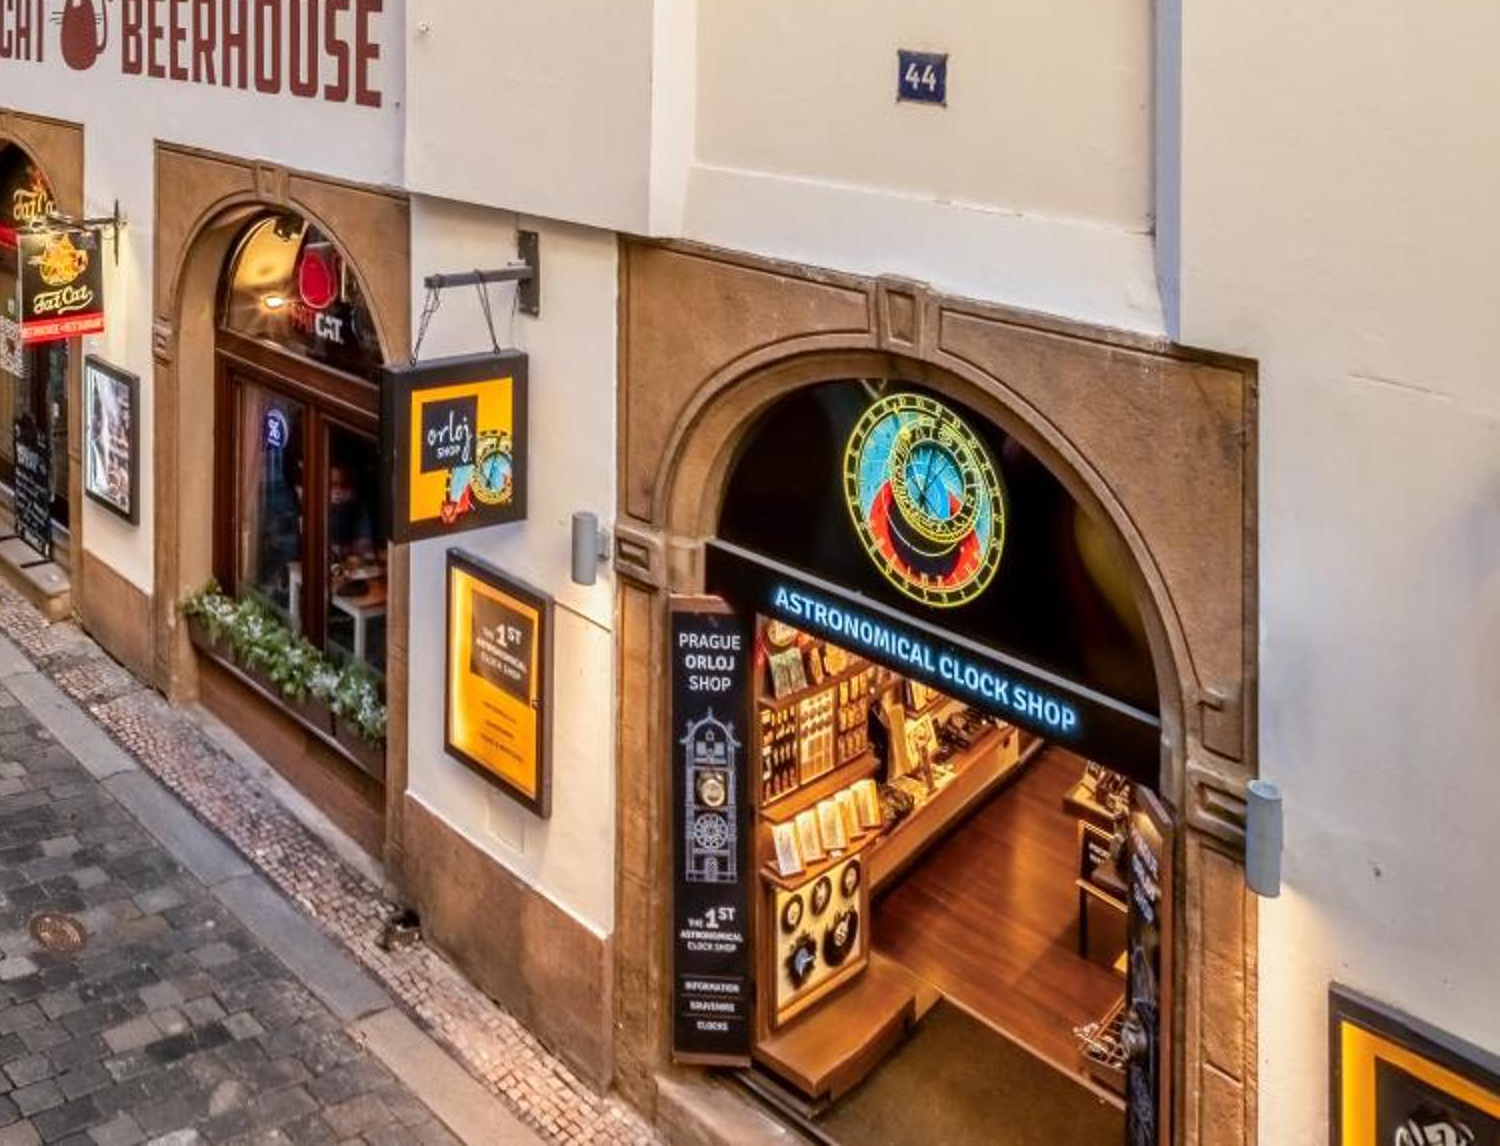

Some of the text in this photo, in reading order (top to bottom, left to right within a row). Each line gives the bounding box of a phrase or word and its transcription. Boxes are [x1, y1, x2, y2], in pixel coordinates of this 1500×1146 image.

[905, 62, 937, 91] 44
[33, 285, 93, 315] Fat Cat
[315, 312, 343, 342] CAT
[427, 410, 472, 463] orloj
[495, 623, 522, 647] 1ST
[679, 633, 741, 651] PRAGUE
[685, 654, 735, 671] ORLOJ
[775, 587, 1076, 732] ASTRONOMICAL CLOCK SHOP
[688, 674, 731, 692] SHOP
[705, 907, 736, 929] 1ST
